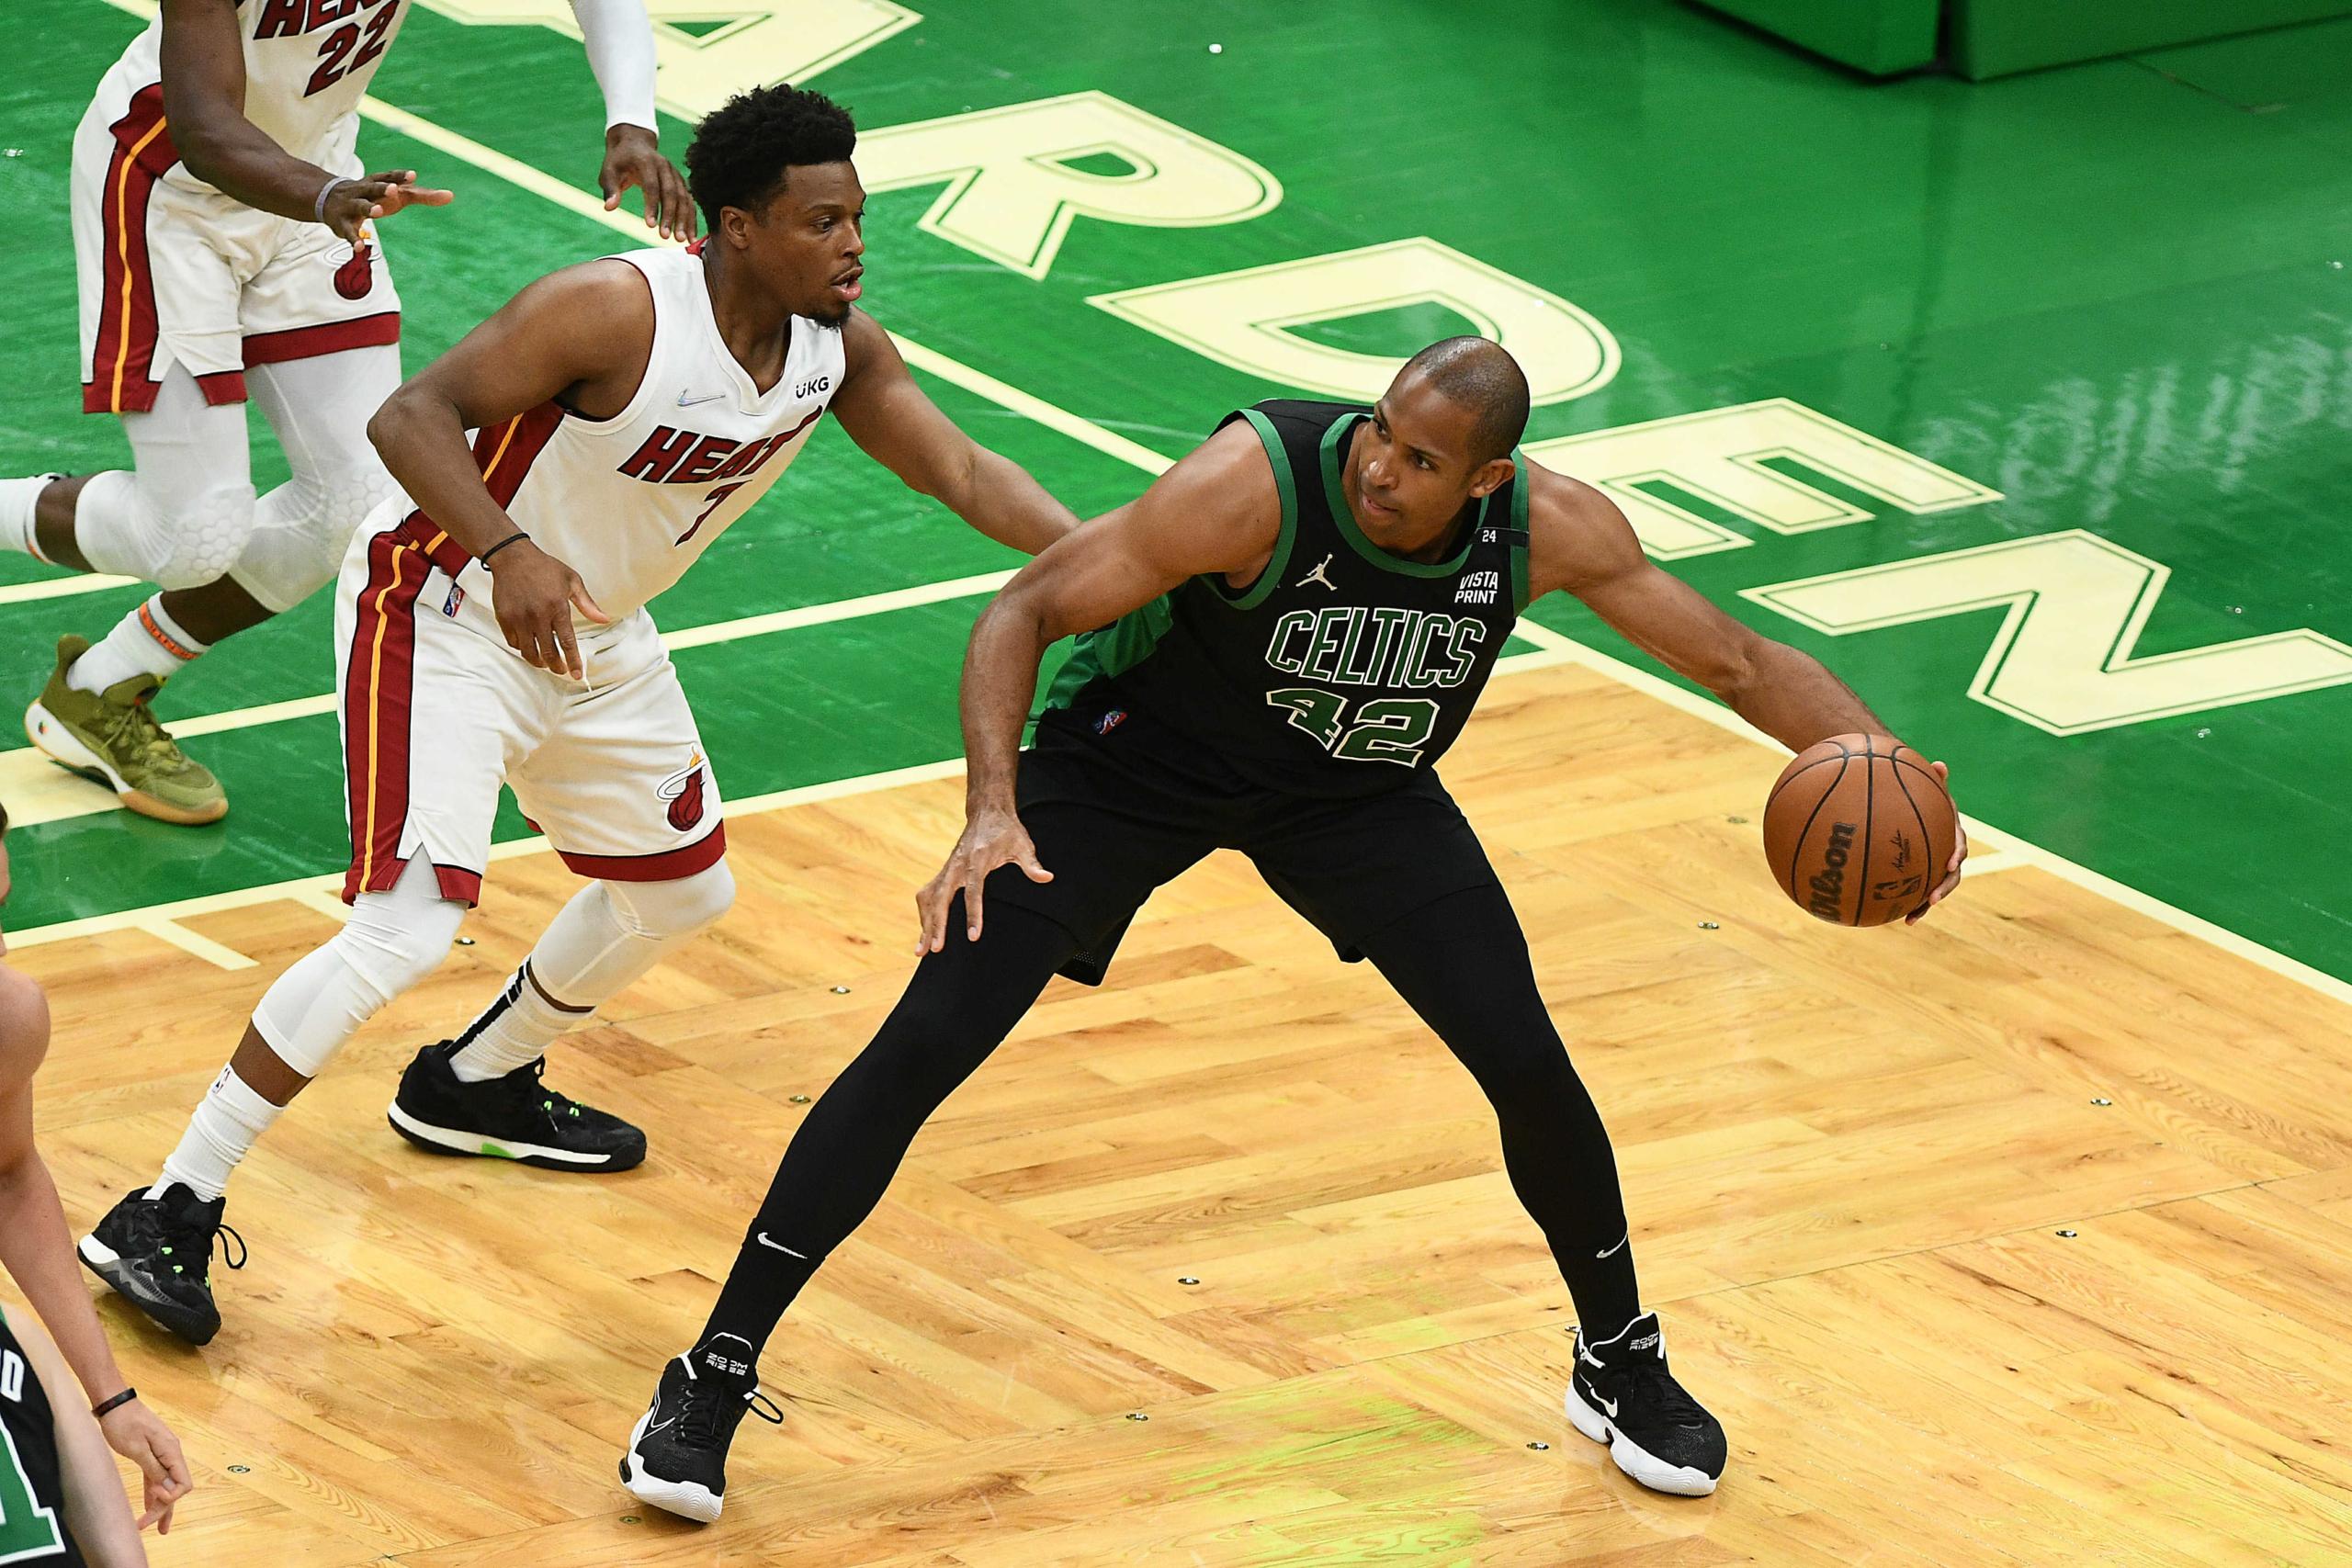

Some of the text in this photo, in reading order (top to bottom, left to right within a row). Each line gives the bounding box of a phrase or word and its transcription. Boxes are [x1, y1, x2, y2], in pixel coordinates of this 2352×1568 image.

[303, 0, 400, 97] 22
[616, 404, 823, 484] HEAT
[674, 479, 753, 547] 7
[1482, 529, 1497, 543] 24
[1454, 590, 1498, 604] PRINT
[1459, 570, 1498, 590] VISTA
[1265, 607, 1487, 688] CELTICS
[1266, 688, 1440, 768] 42
